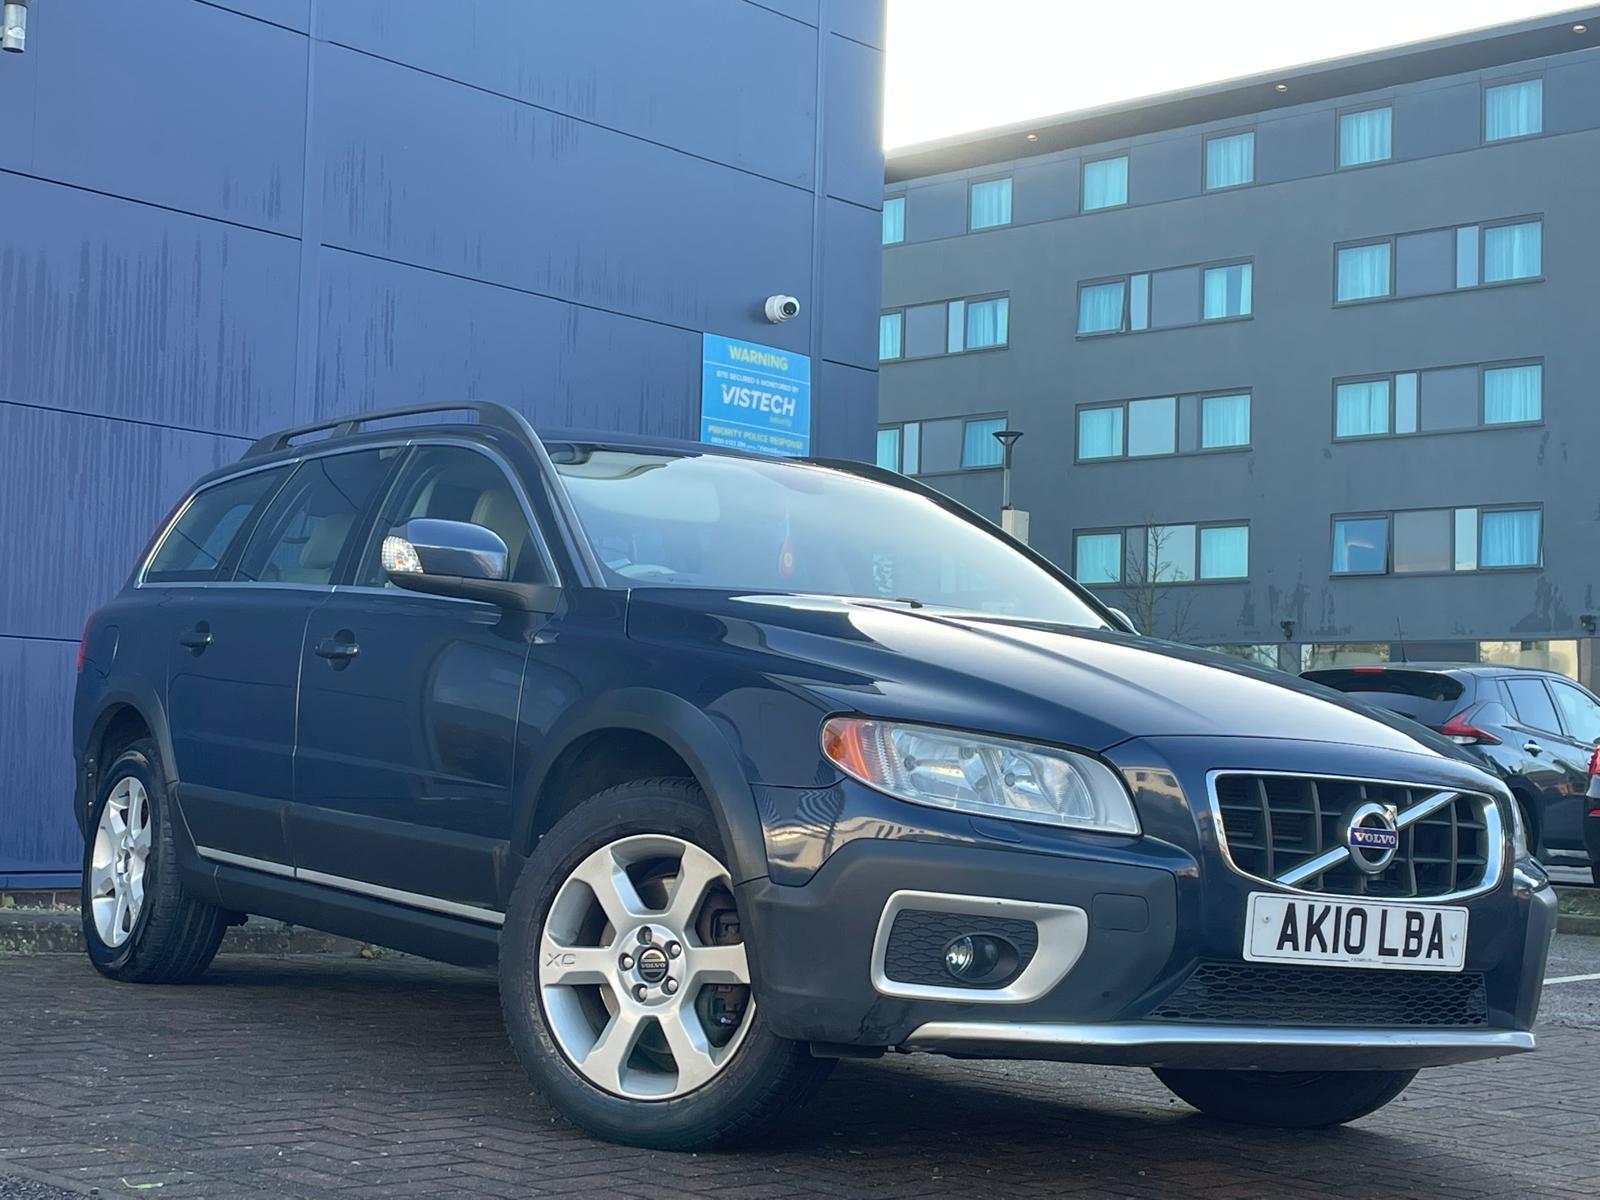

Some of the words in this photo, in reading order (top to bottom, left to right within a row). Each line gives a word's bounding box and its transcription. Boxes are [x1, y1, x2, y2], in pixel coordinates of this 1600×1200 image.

[729, 345, 788, 371] WARNING
[721, 383, 796, 417] VISTECH
[1353, 832, 1396, 845] VOLVO
[1276, 903, 1367, 954] AK10
[1378, 909, 1444, 959] LBA
[546, 952, 577, 967] XC
